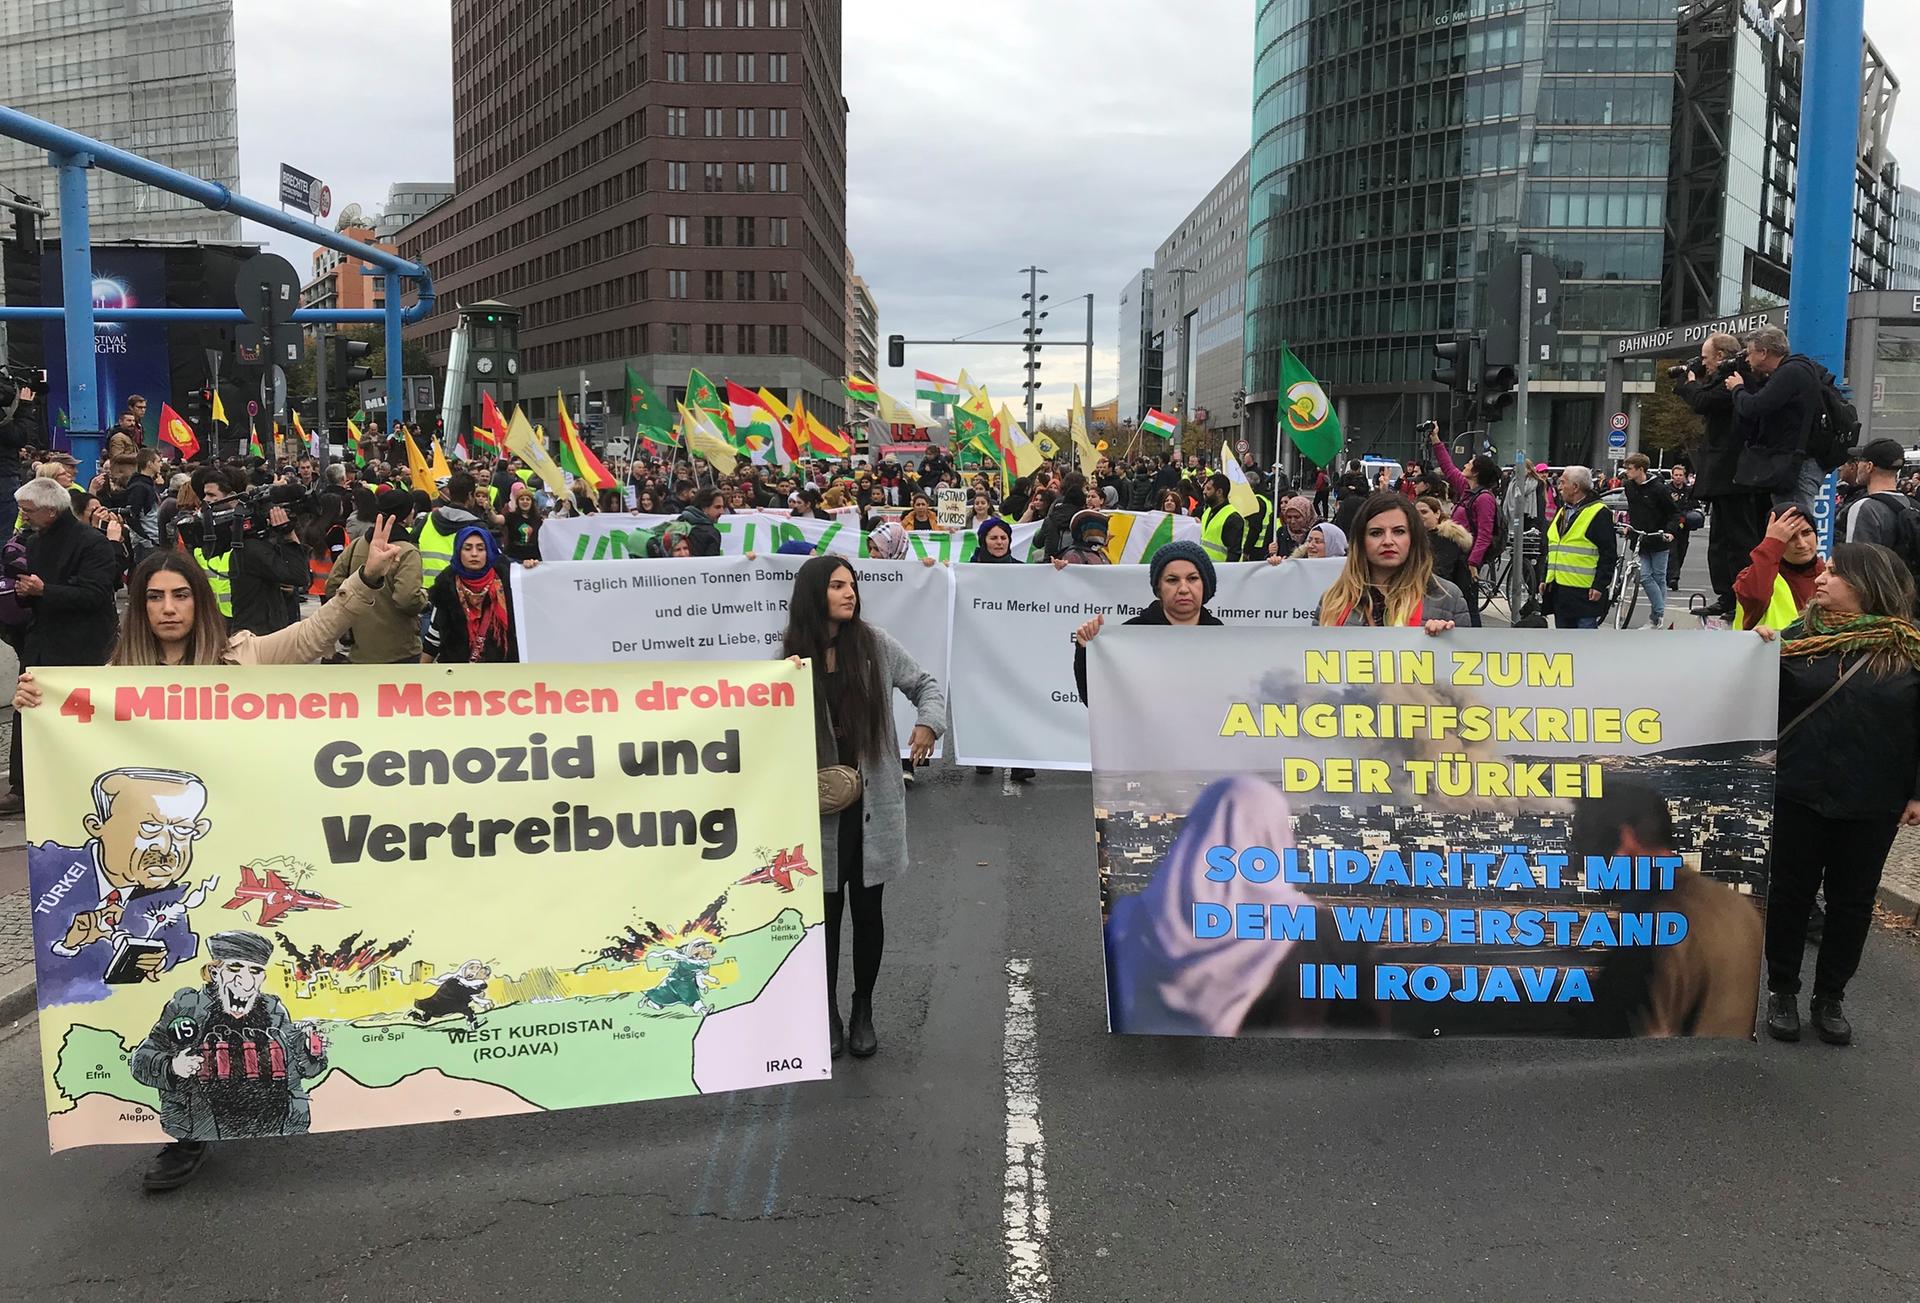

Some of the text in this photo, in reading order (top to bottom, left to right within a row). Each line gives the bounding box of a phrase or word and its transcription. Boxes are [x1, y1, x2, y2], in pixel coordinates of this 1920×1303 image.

[94, 335, 124, 345] STIVAL
[1619, 331, 1674, 353] BAHNHOF
[1684, 314, 1769, 342] POTSDAMER
[94, 344, 127, 354] IGHTS
[938, 512, 965, 525] KURDS
[574, 577, 628, 592] Täglich
[631, 573, 697, 588] Millionen
[700, 571, 751, 585] Tonnen
[856, 570, 904, 582] Mensch
[655, 605, 682, 619] und
[686, 604, 708, 616] die
[711, 601, 763, 615] Umwelt
[766, 600, 777, 613] in
[973, 598, 1143, 615] Frau Merkel und Herr Maa
[1217, 606, 1261, 619] immer
[1264, 609, 1288, 620] nur
[1292, 606, 1317, 620] bes
[612, 631, 784, 653] Der Umwelt zu Liebe, geb
[1304, 649, 1574, 687] NEIN ZUM
[60, 679, 795, 723] 4 Millionen Menschen drohen
[1051, 690, 1082, 703] Geb
[1219, 703, 1662, 744] ANGRIFFSKRIEG
[314, 729, 741, 788] Genozid und
[1282, 753, 1604, 799] DER TÜRKEI
[322, 801, 738, 864] Vertreibung
[1205, 845, 1683, 891] SOLIDARITÄT MIT
[35, 861, 88, 916] TÜRKEI
[1193, 902, 1689, 947] DEM WIDERSTAND
[771, 933, 800, 943] Hemko
[1300, 963, 1595, 1003] IN ROJAVA
[173, 1020, 194, 1039] IS
[448, 1017, 613, 1045] WEST KURDISTAN
[473, 1041, 559, 1063] (ROJAVA)
[766, 1057, 803, 1073] IRAQ
[119, 1113, 155, 1123] Aleppo
